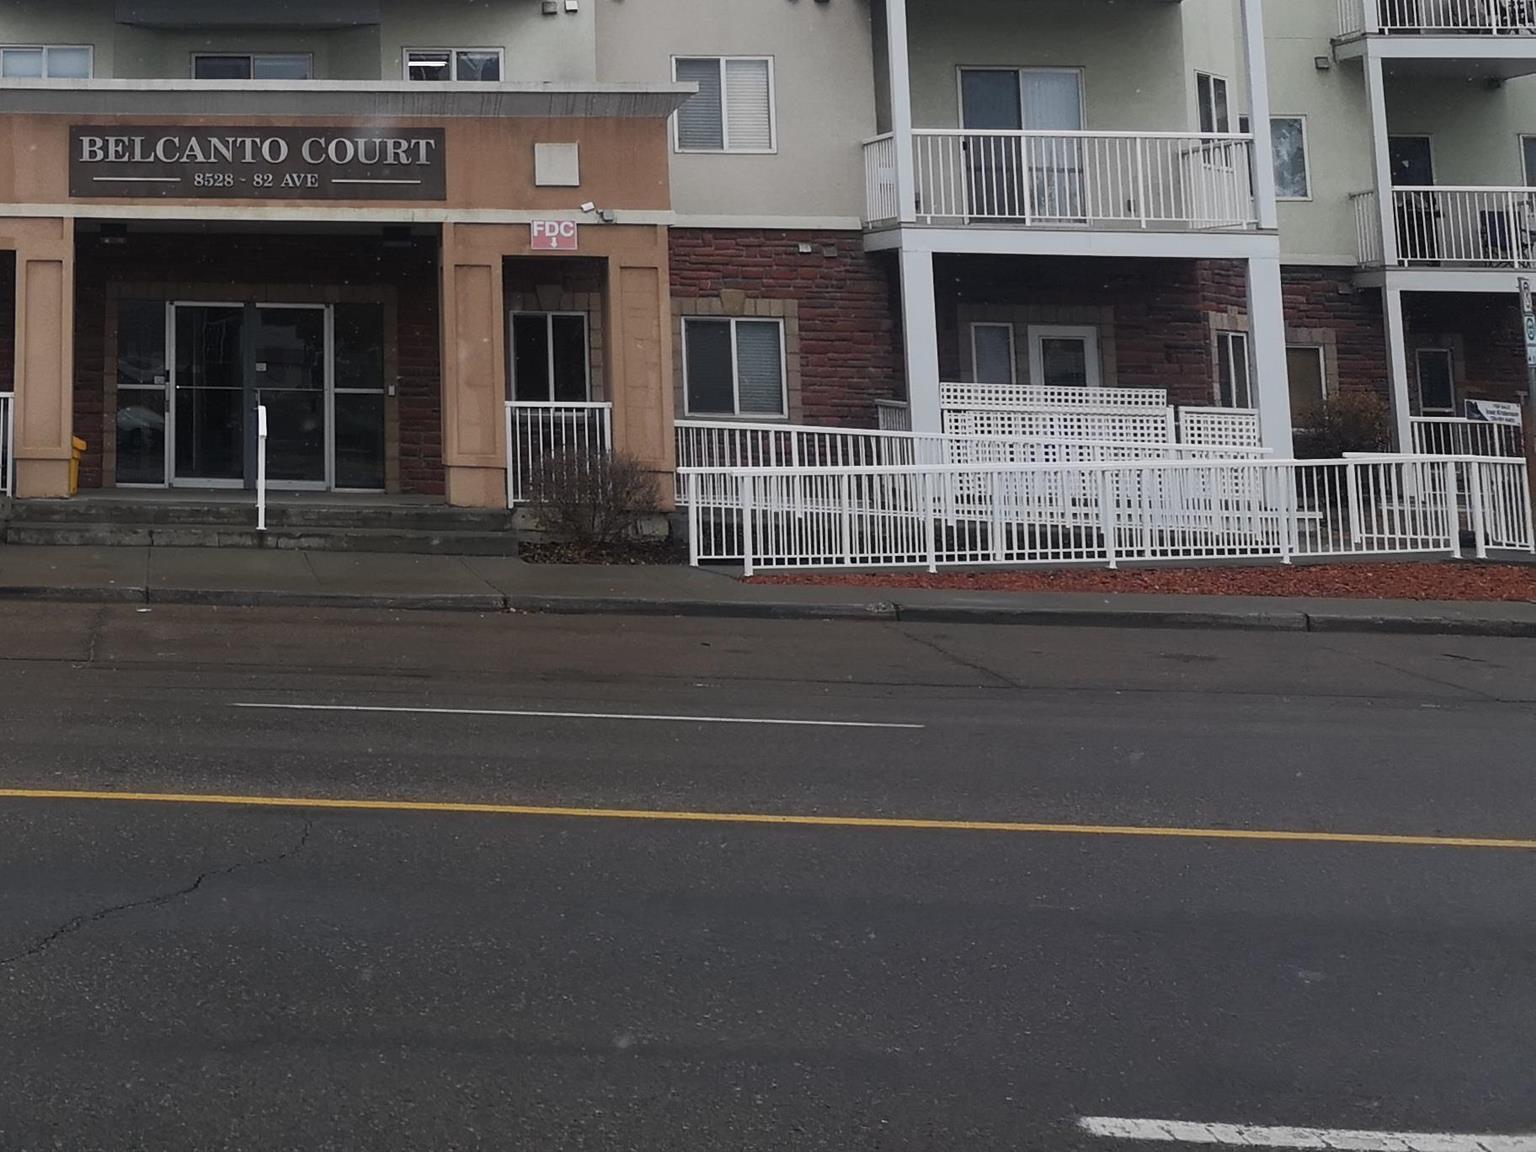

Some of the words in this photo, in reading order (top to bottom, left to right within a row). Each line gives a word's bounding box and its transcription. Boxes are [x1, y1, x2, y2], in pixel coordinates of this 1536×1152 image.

[78, 135, 289, 164] BELCANTO
[301, 137, 436, 165] COURT
[193, 172, 234, 187] 8528
[252, 172, 273, 187] 82
[280, 173, 319, 188] AVE
[532, 221, 574, 237] FDC
